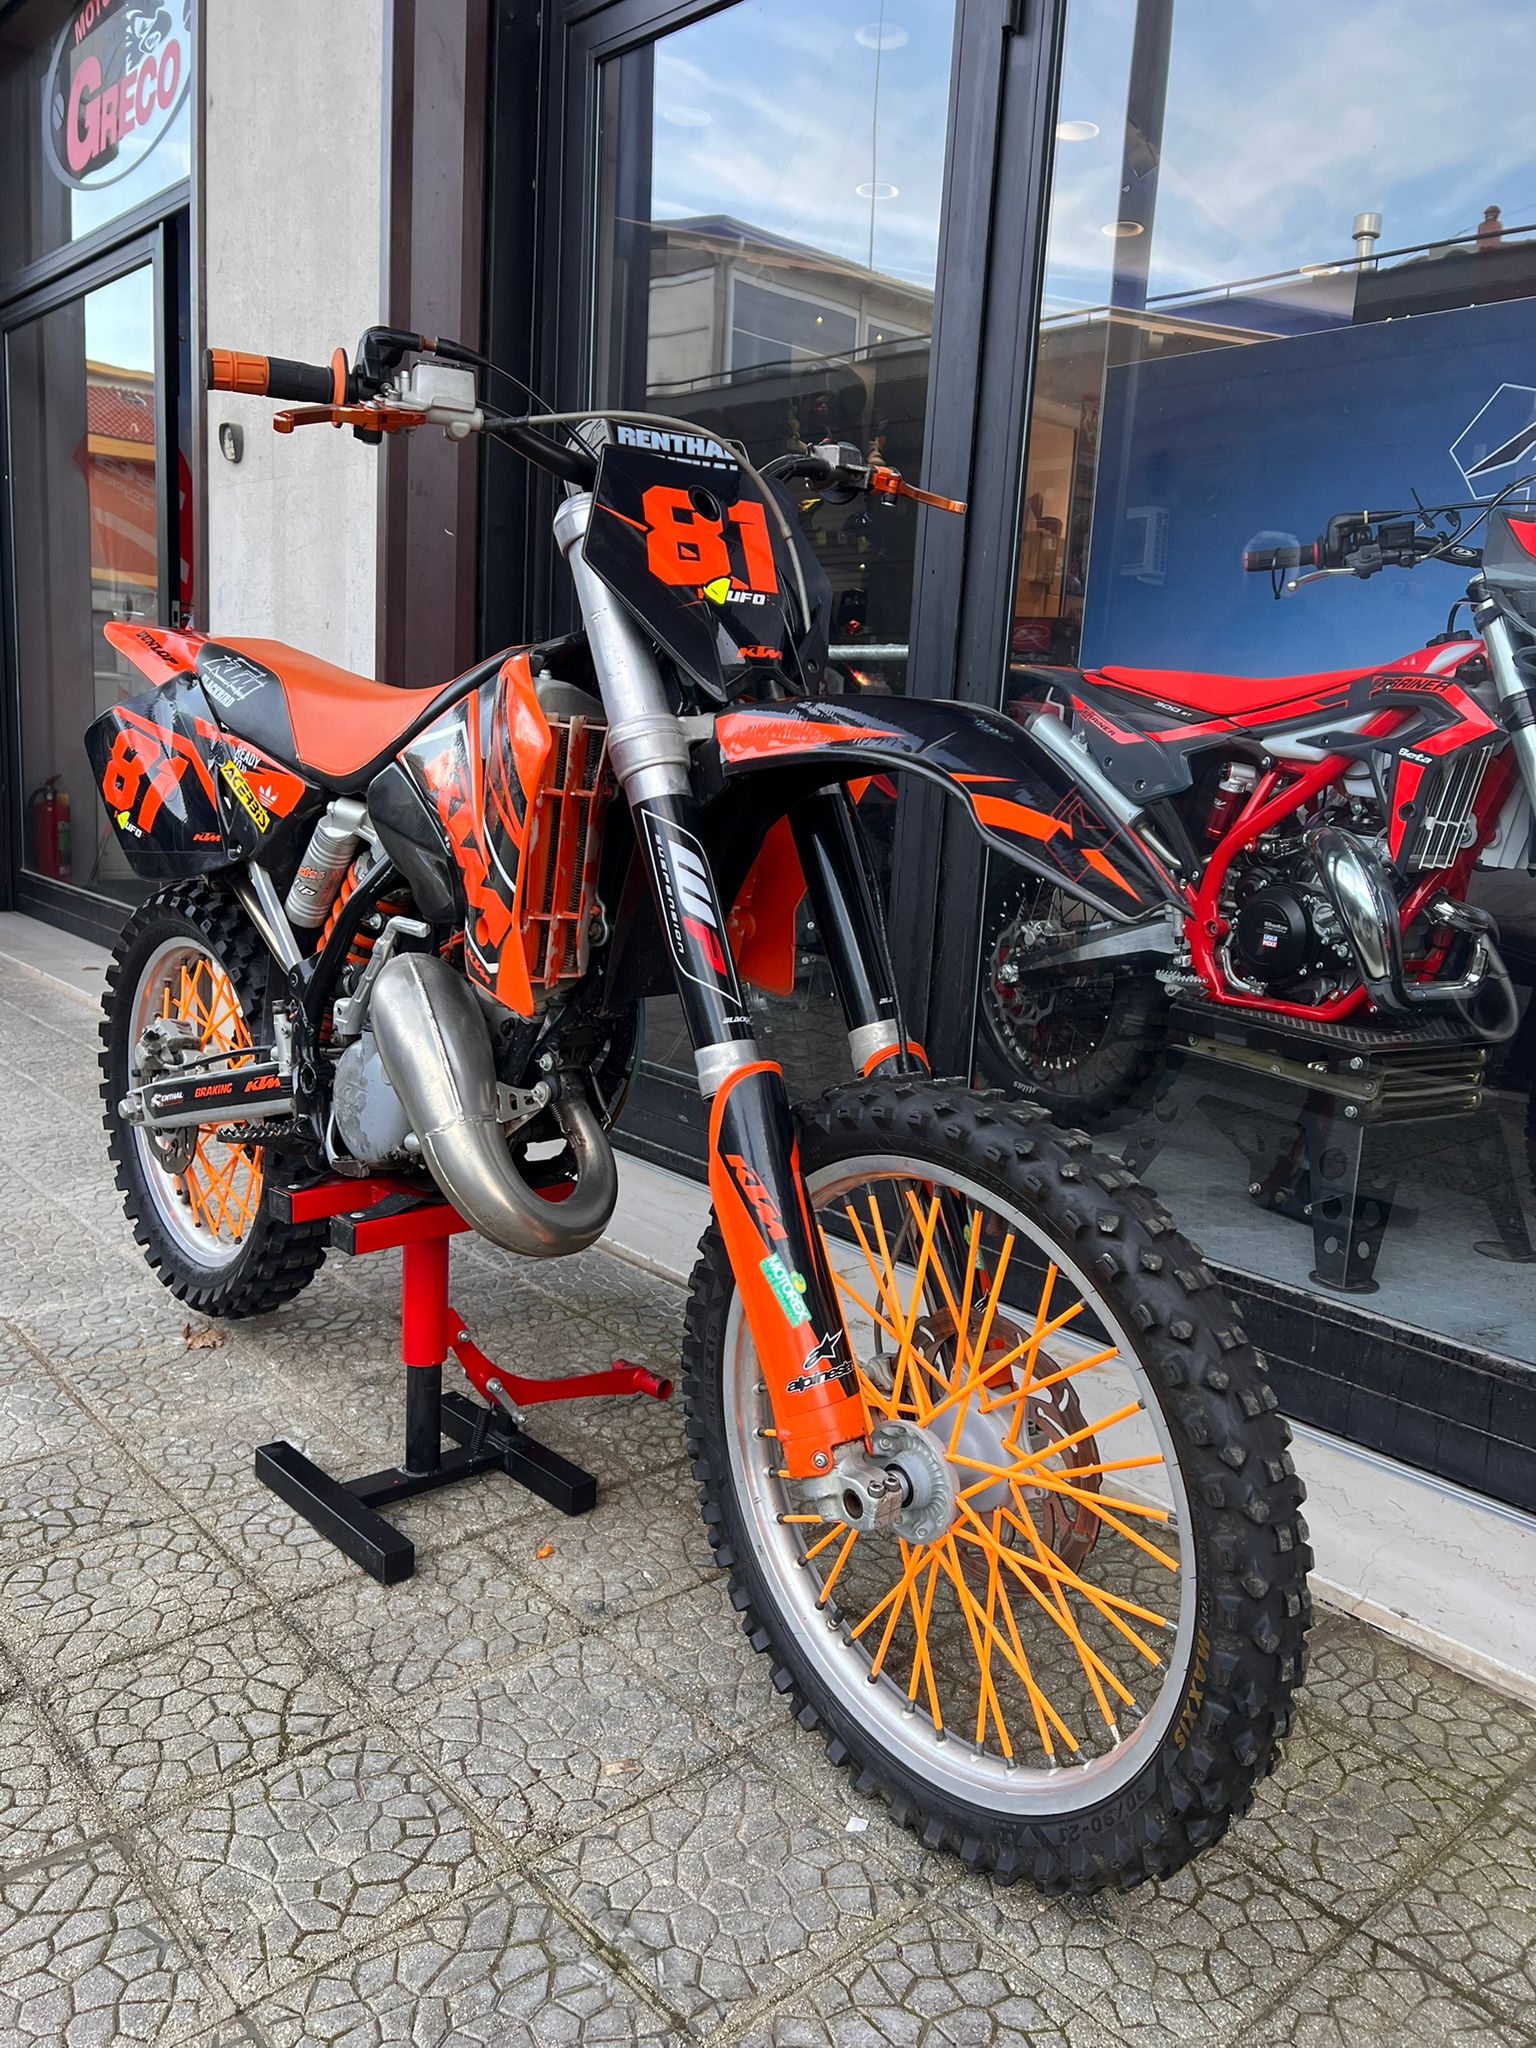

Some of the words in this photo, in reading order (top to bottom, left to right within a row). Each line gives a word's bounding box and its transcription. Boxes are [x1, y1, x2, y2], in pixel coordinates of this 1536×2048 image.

[67, 39, 181, 171] GRECO
[642, 485, 778, 593] 81
[726, 590, 766, 605] UFO
[137, 631, 179, 664] DUNLOP
[737, 646, 782, 660] KTM
[201, 674, 236, 708] BLACKBIRD
[1154, 701, 1181, 713] 300
[235, 745, 261, 769] READY
[1399, 747, 1432, 764] Beta
[102, 729, 189, 833] 81
[223, 767, 266, 829] ACERBIS
[125, 821, 142, 838] UFO
[192, 833, 221, 842] KTM
[654, 833, 684, 954] suspension
[194, 1083, 233, 1099] BRAKING
[244, 1075, 281, 1092] KTM
[725, 1154, 788, 1241] KTM
[767, 1254, 807, 1322] MOTOREX
[786, 1361, 854, 1393] alpinesta
[1173, 1629, 1211, 1750] MAXXIS
